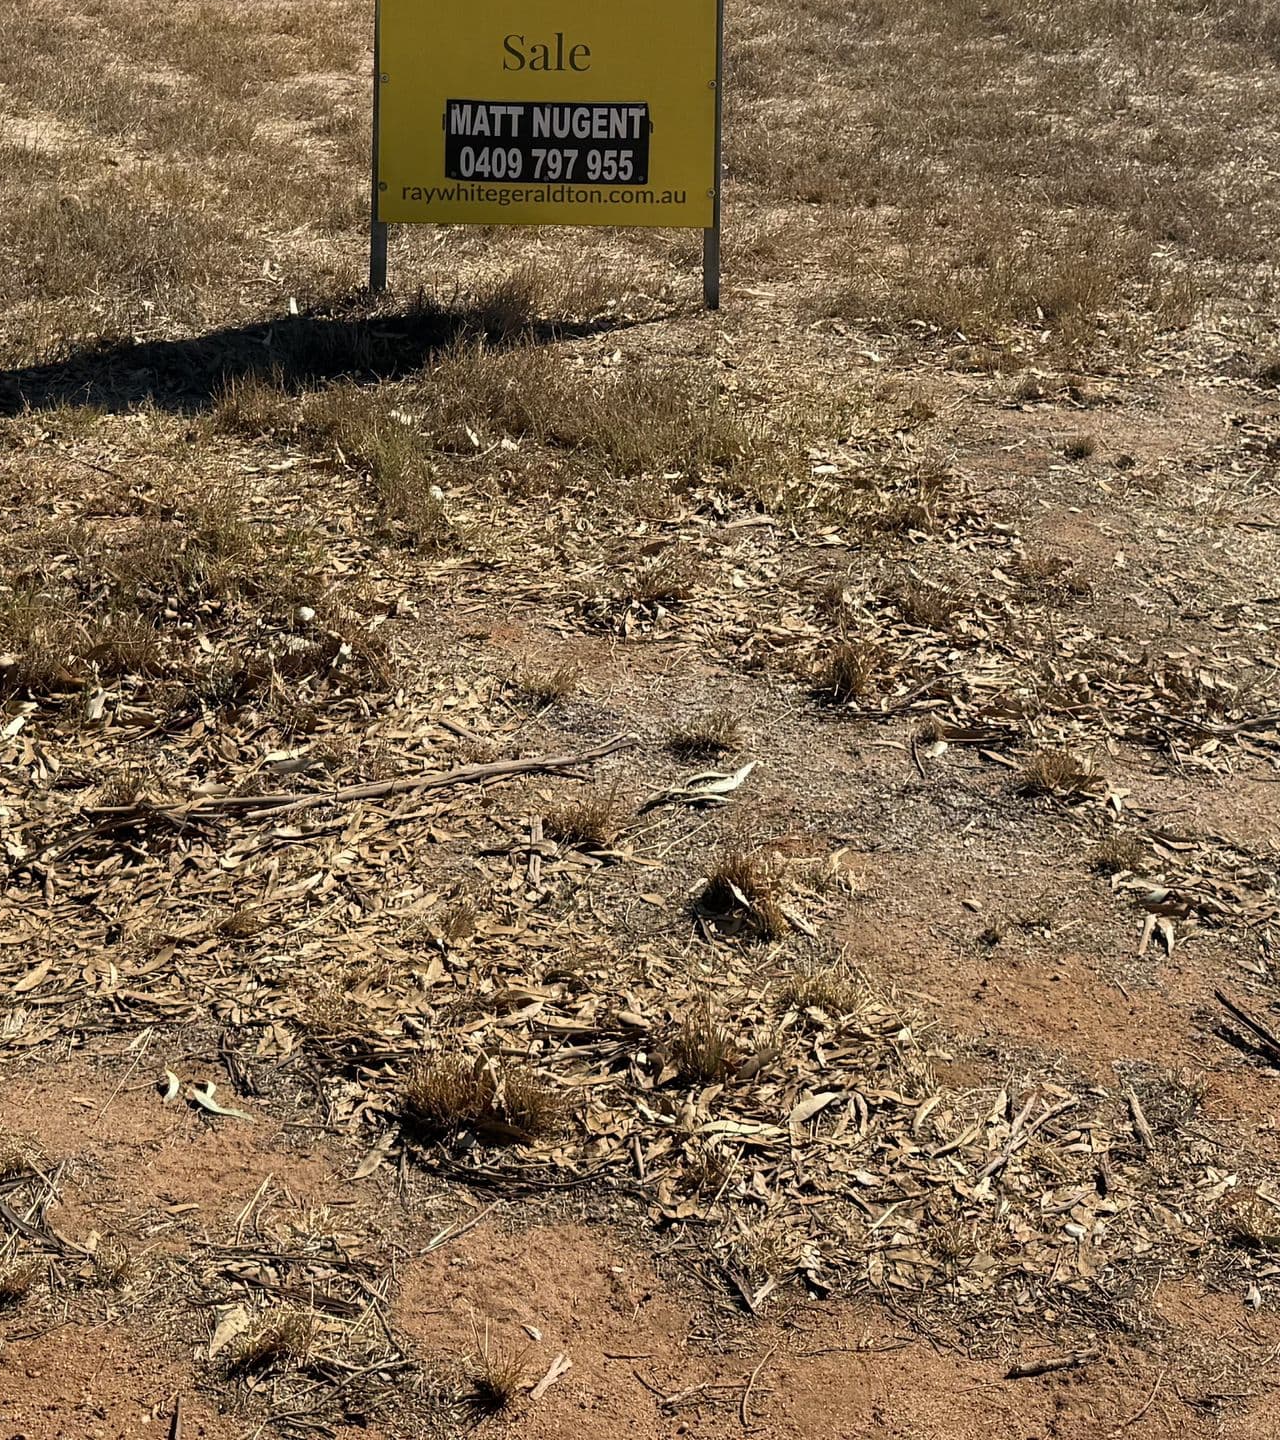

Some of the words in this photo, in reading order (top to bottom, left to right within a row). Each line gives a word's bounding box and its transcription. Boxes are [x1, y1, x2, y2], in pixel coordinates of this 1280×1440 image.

[502, 32, 592, 71] Sale
[450, 104, 523, 137] MATT
[532, 106, 646, 139] NUGENT
[459, 146, 523, 178] 0409
[531, 148, 579, 180] 797
[586, 149, 634, 181] 955
[401, 182, 687, 206] raywhitegeraldton.com.au
